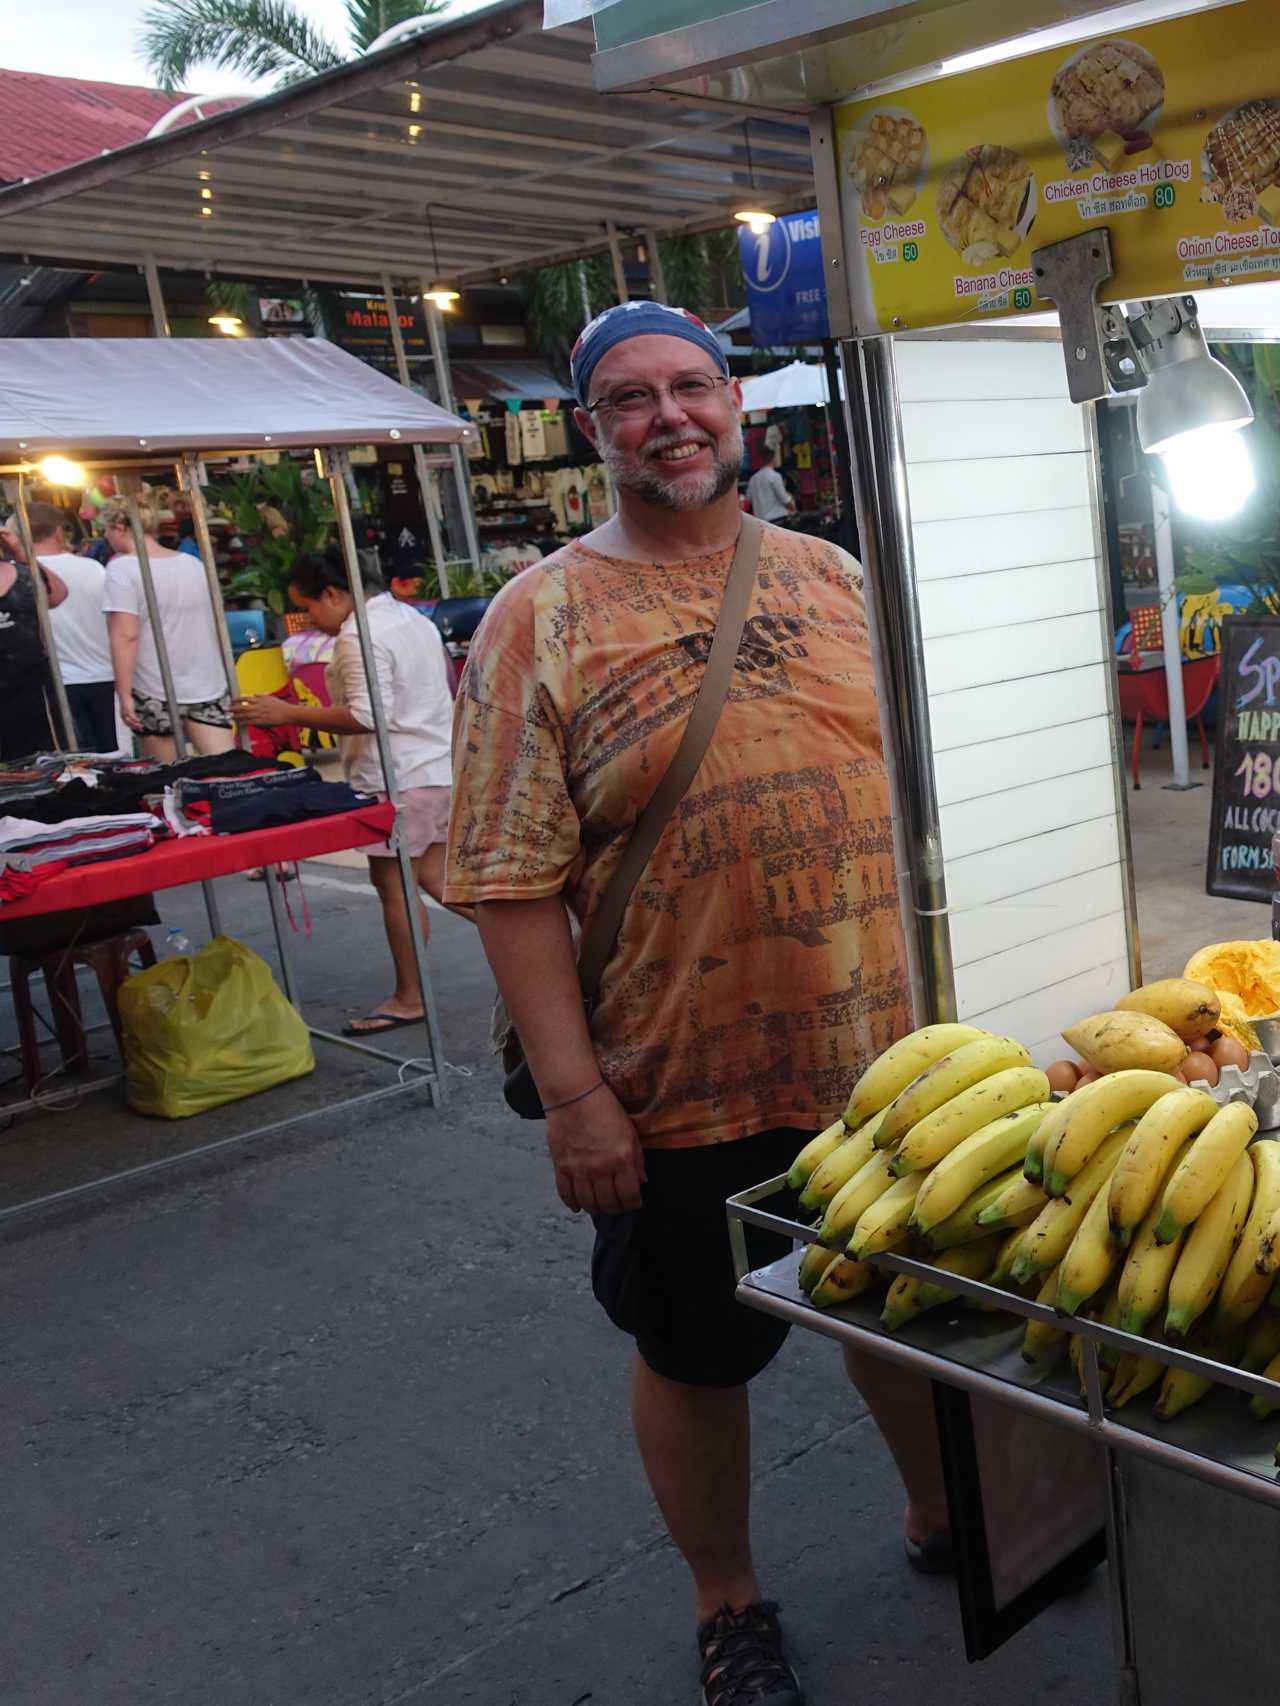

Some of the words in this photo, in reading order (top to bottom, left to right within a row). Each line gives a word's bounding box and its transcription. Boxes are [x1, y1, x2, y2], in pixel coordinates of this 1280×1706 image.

[1045, 182, 1089, 201] Chicken
[1093, 172, 1137, 191] Cheese
[1140, 166, 1161, 183] Hot
[1164, 162, 1190, 179] Dog
[1155, 187, 1174, 206] 80
[860, 230, 880, 247] Egg
[883, 222, 924, 241] Cheese
[1179, 239, 1212, 258] Onion
[1214, 232, 1259, 252] Cheese
[903, 243, 918, 259] 50
[955, 275, 997, 295] Banana
[999, 270, 1034, 288] Chees
[1015, 290, 1031, 307] 50
[1224, 804, 1250, 831] ALL
